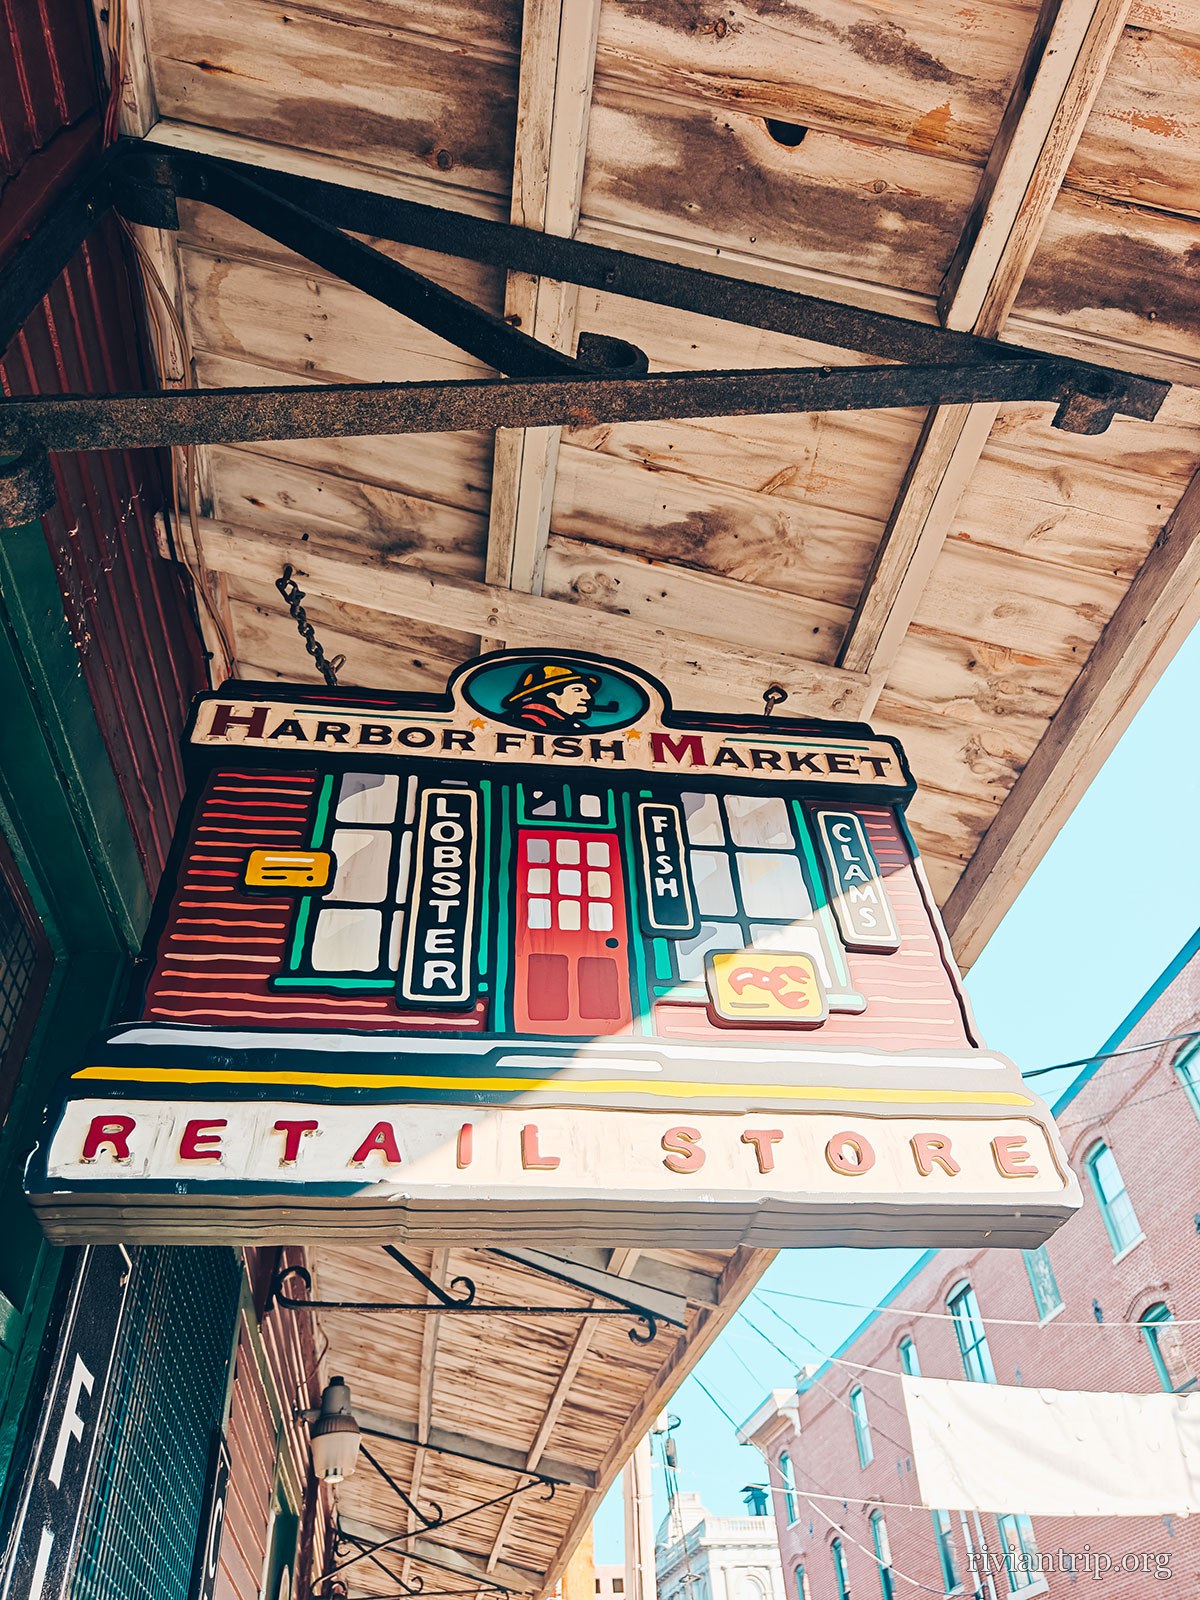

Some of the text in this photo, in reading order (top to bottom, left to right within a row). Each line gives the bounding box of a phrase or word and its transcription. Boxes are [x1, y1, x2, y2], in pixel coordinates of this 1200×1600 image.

[206, 704, 892, 779] HARBOR FISH MARKET
[422, 796, 465, 991] LOBSTER
[652, 815, 680, 899] FISH
[832, 822, 878, 929] CLAMS
[80, 1115, 1040, 1179] RETAIL STORE
